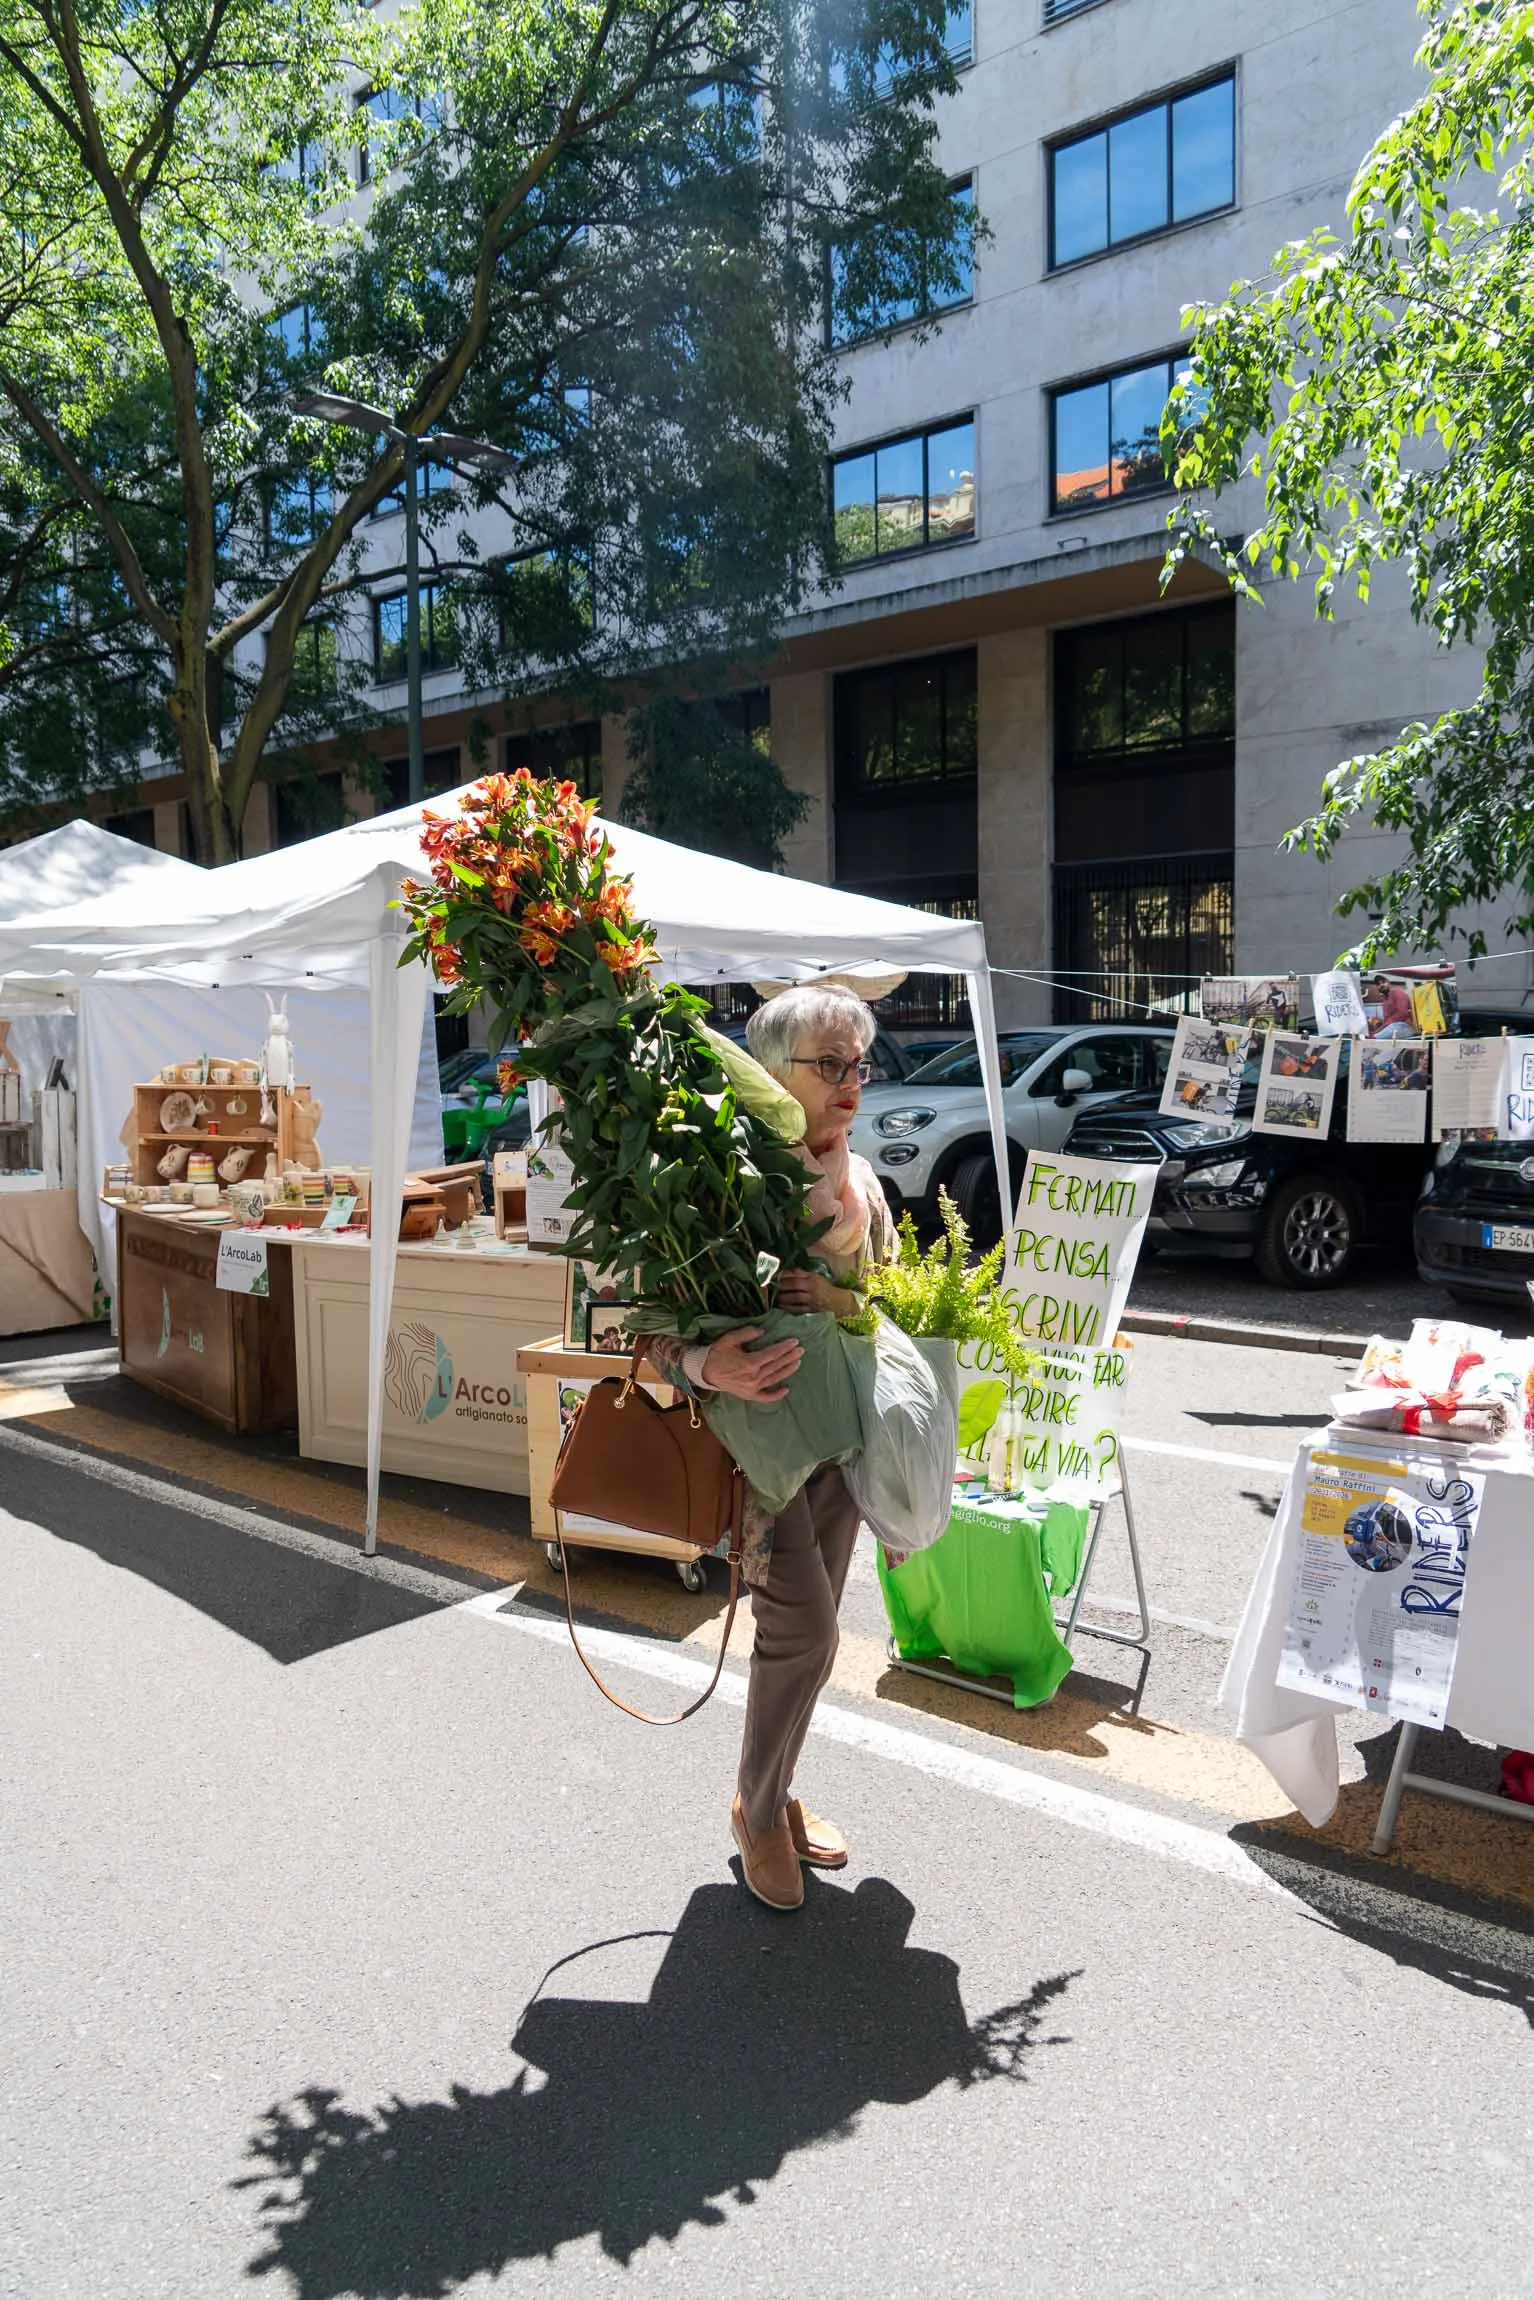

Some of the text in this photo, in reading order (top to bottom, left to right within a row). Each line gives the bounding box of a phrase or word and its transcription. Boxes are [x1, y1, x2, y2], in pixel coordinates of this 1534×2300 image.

[221, 1244, 262, 1263] L'ArcoLab
[1000, 1288, 1100, 1347] SCRIVI
[956, 1338, 1019, 1374] COS
[1092, 1351, 1127, 1390] FAR
[438, 1375, 527, 1408] L'ArcoL
[1314, 1476, 1377, 1493] Mauro Raffini
[1400, 1479, 1479, 1618] RIDERS
